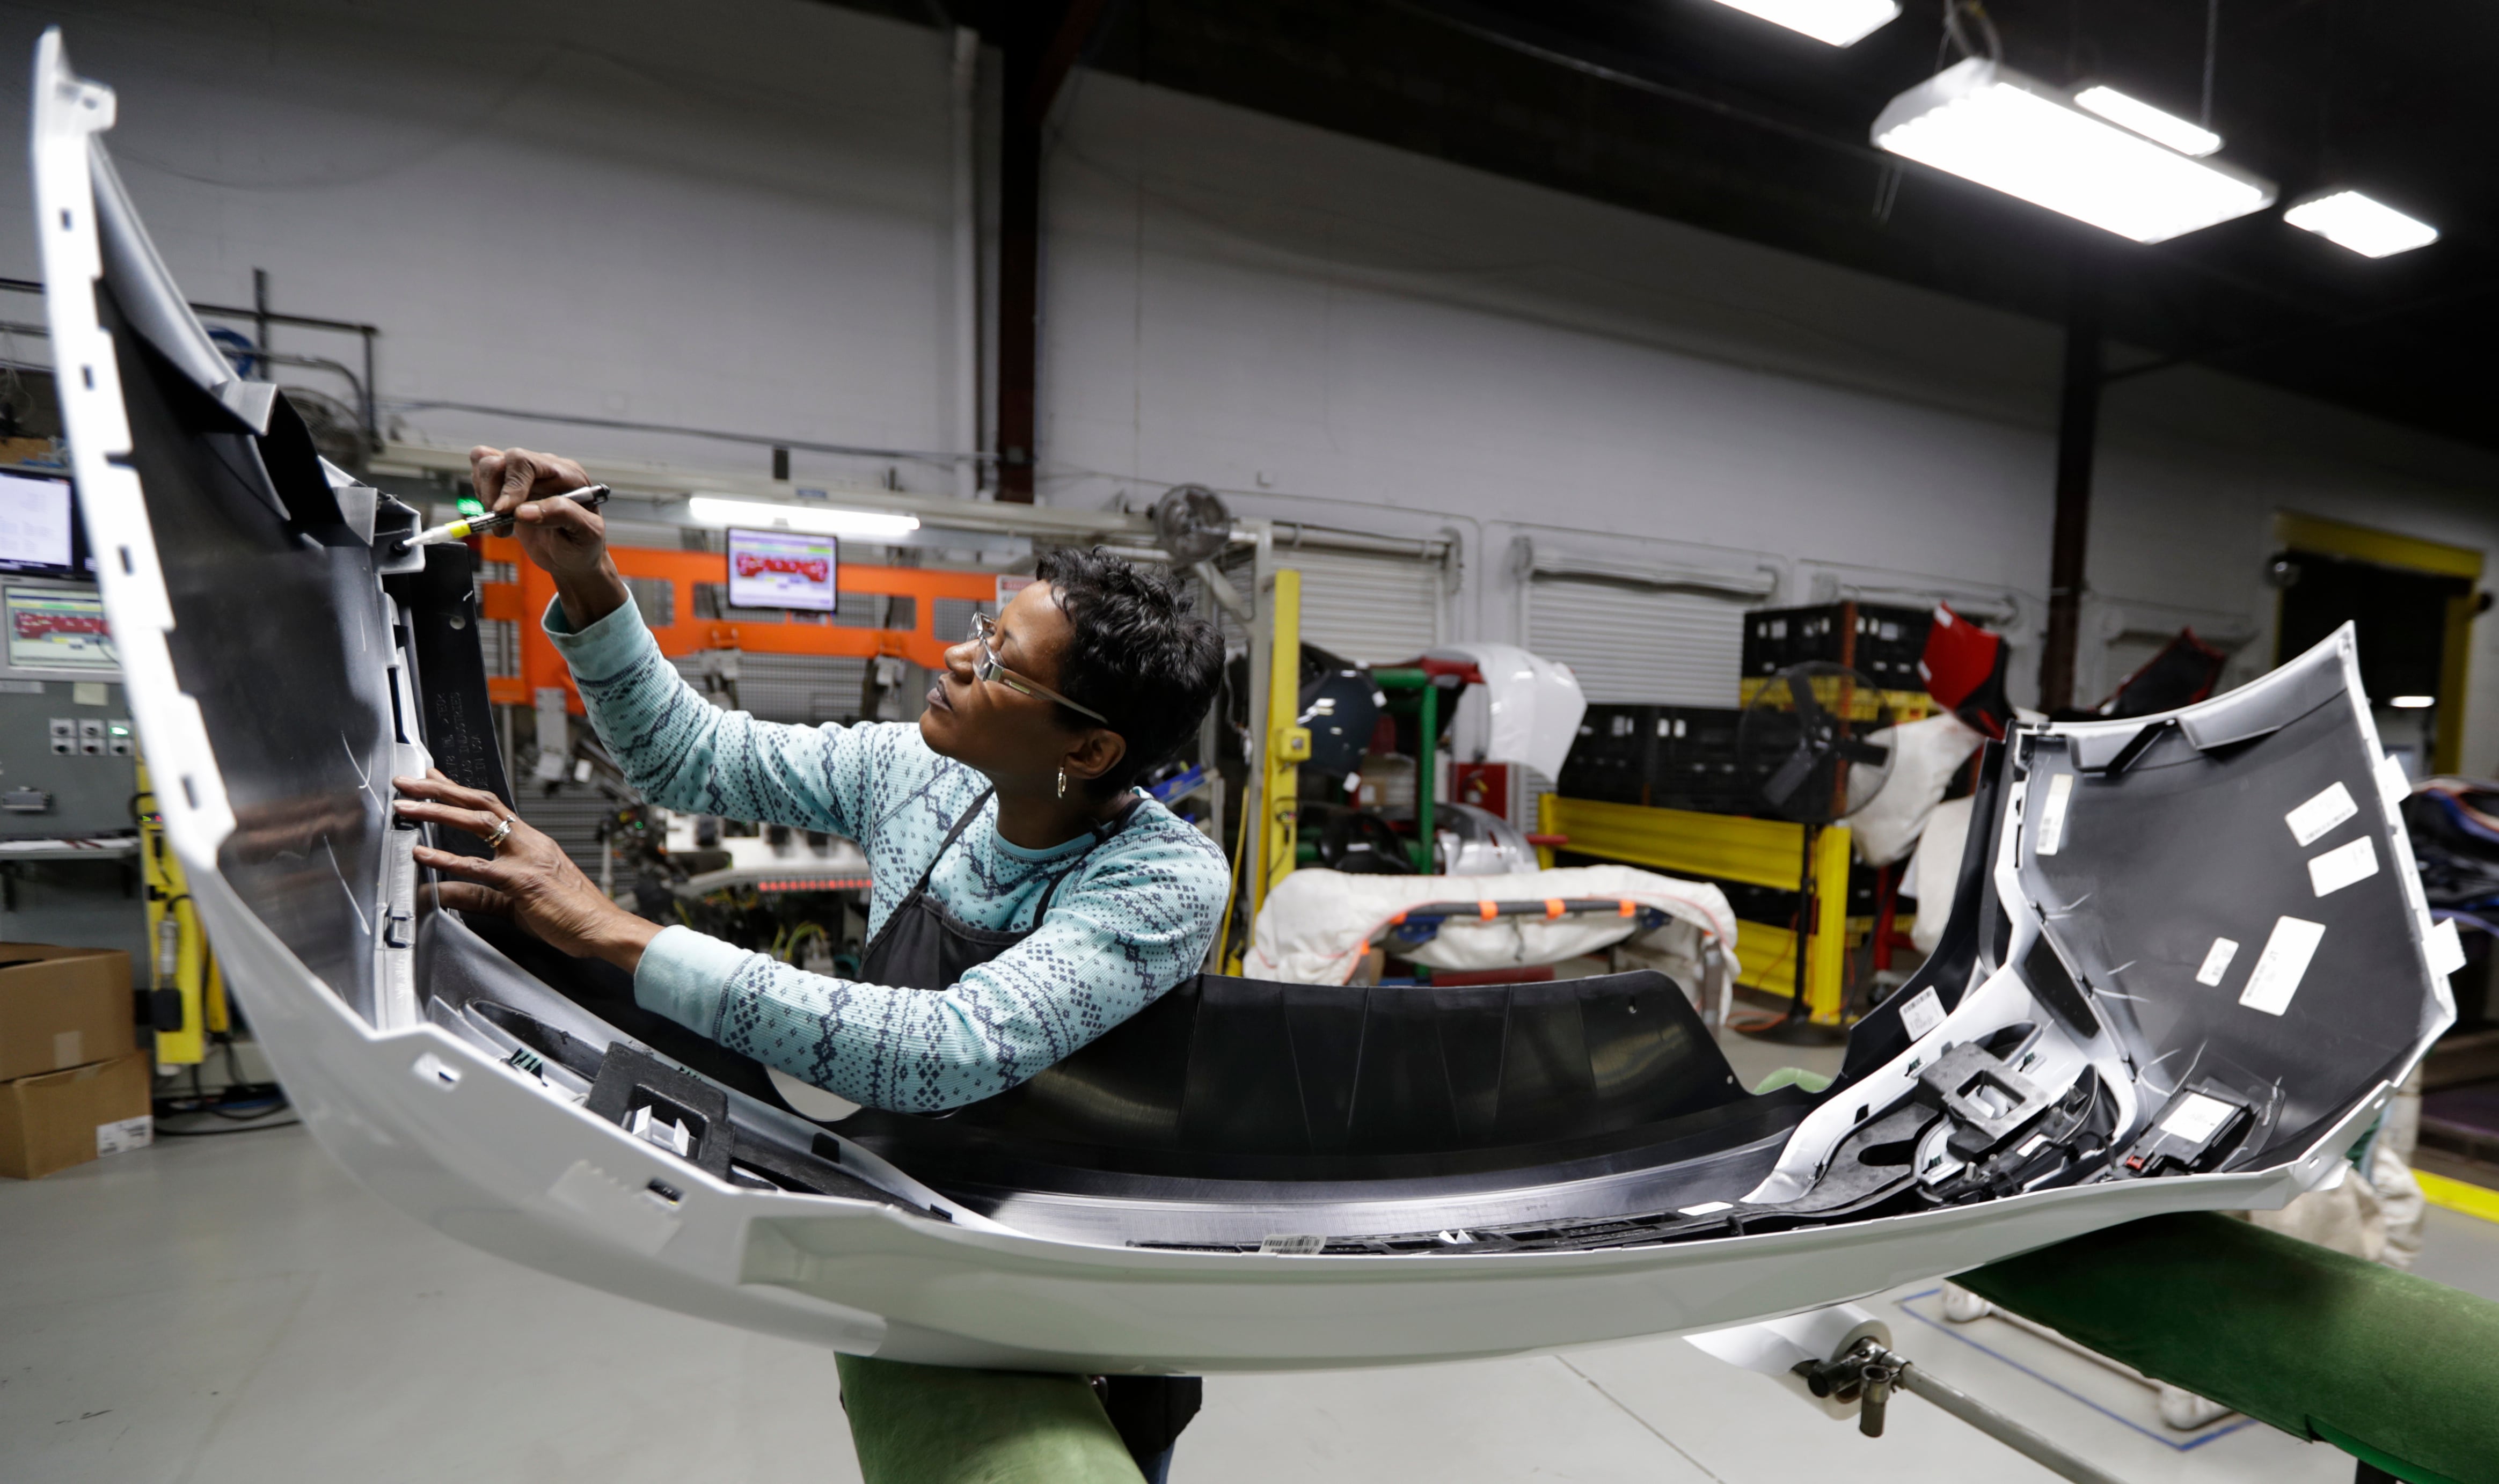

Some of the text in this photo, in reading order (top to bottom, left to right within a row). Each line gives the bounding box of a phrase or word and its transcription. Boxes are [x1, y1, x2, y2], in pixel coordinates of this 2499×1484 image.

[450, 692, 469, 754] INDUSTRIES
[471, 735, 483, 754] USA
[474, 758, 486, 772] IN
